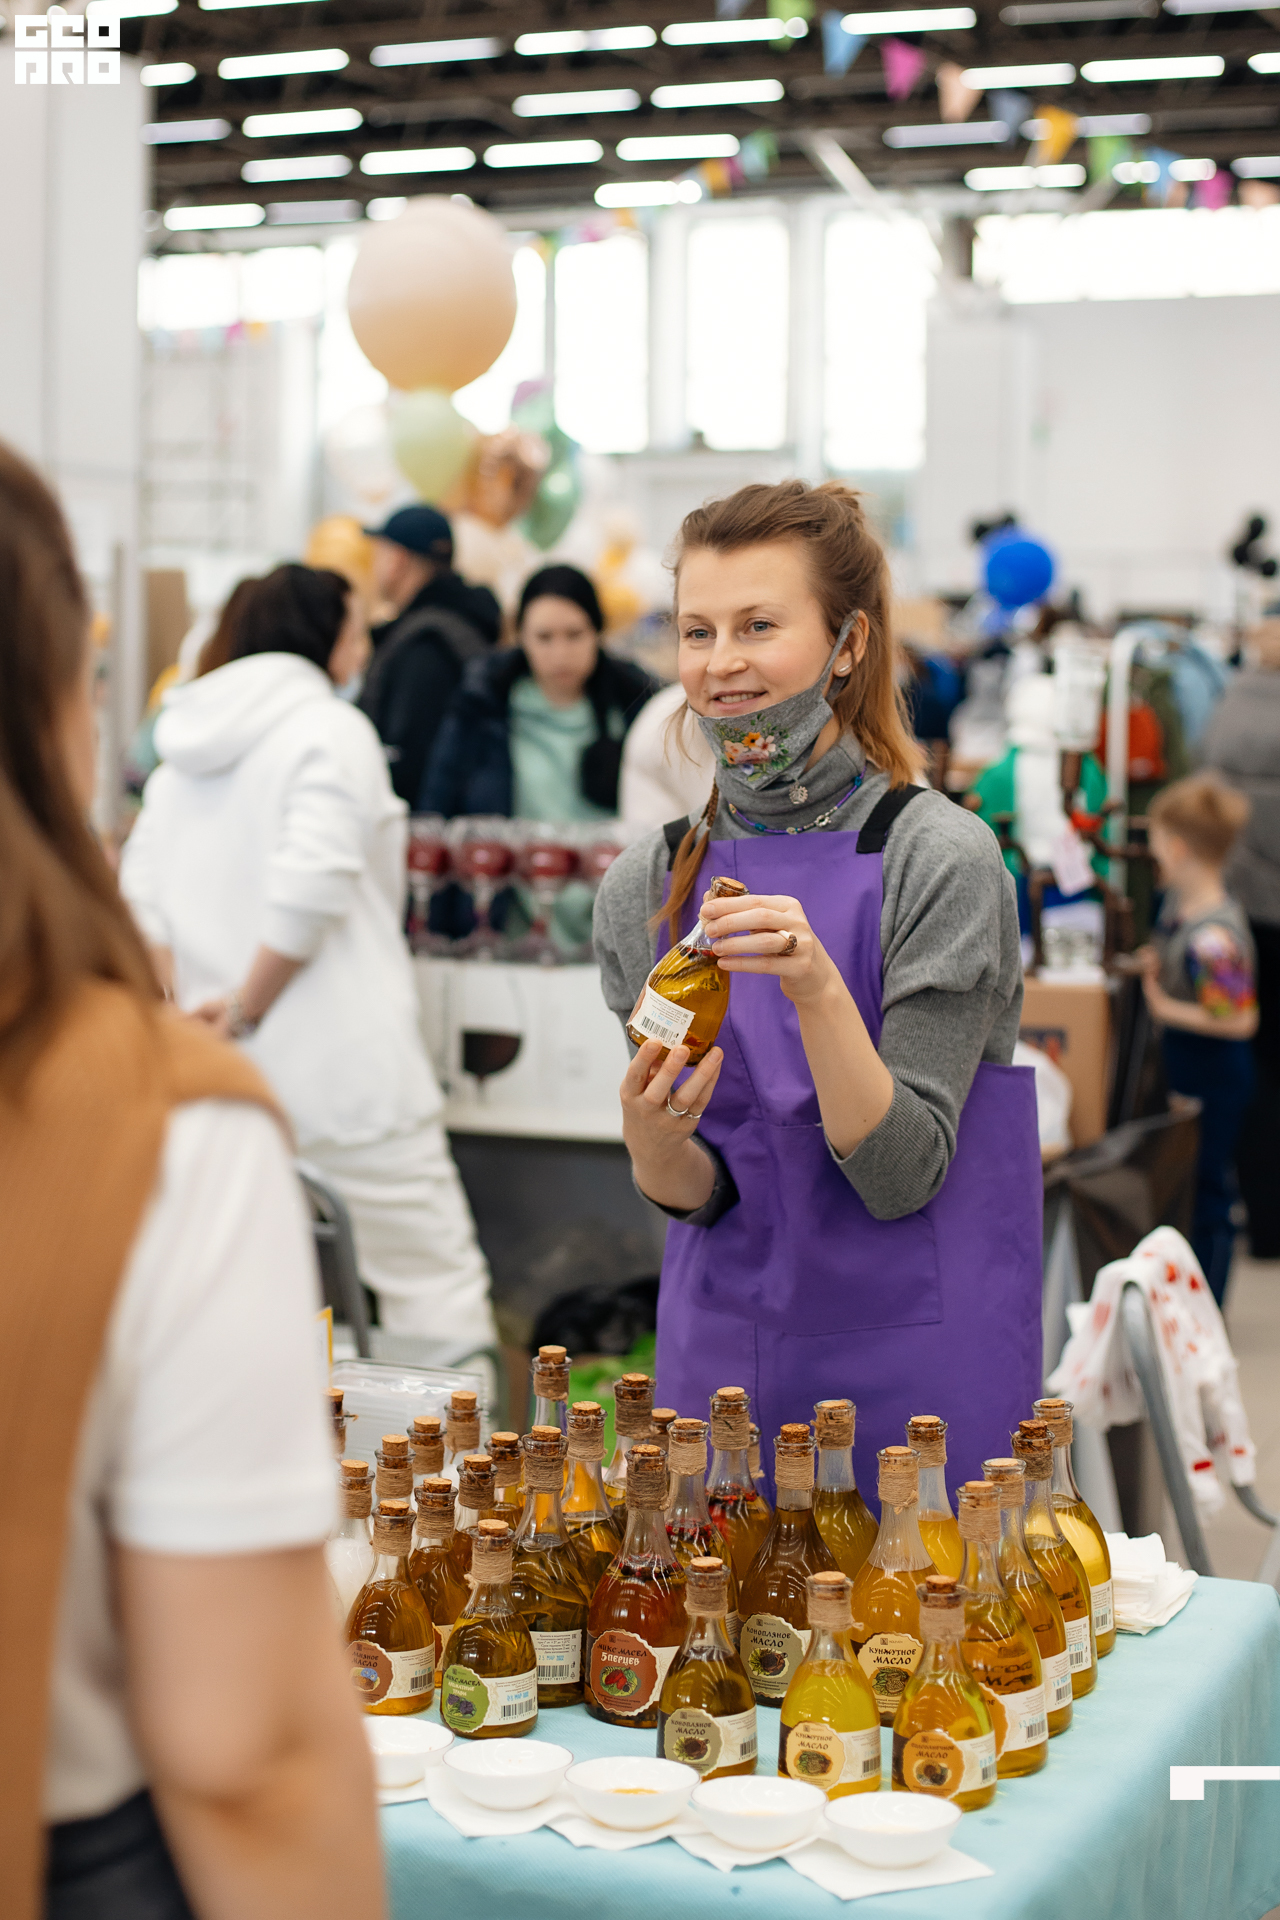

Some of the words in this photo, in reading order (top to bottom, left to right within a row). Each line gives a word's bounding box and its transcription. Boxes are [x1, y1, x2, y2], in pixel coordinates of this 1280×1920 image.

[746, 1626, 791, 1639] КОНОПЛЯНОЕ
[750, 1636, 784, 1648] МАСЛО
[618, 1648, 647, 1657] МАСЕЛ
[868, 1647, 916, 1656] КУНЖУТНОЕ
[873, 1656, 911, 1665] МАСЛО
[670, 1719, 712, 1728] КОНОПЛЯНОЕ
[675, 1727, 706, 1736] МАСЛО
[795, 1732, 833, 1742] КУНЖУТНОЕ
[798, 1741, 829, 1750] МАСЛО
[916, 1750, 949, 1759] МАСЛО
